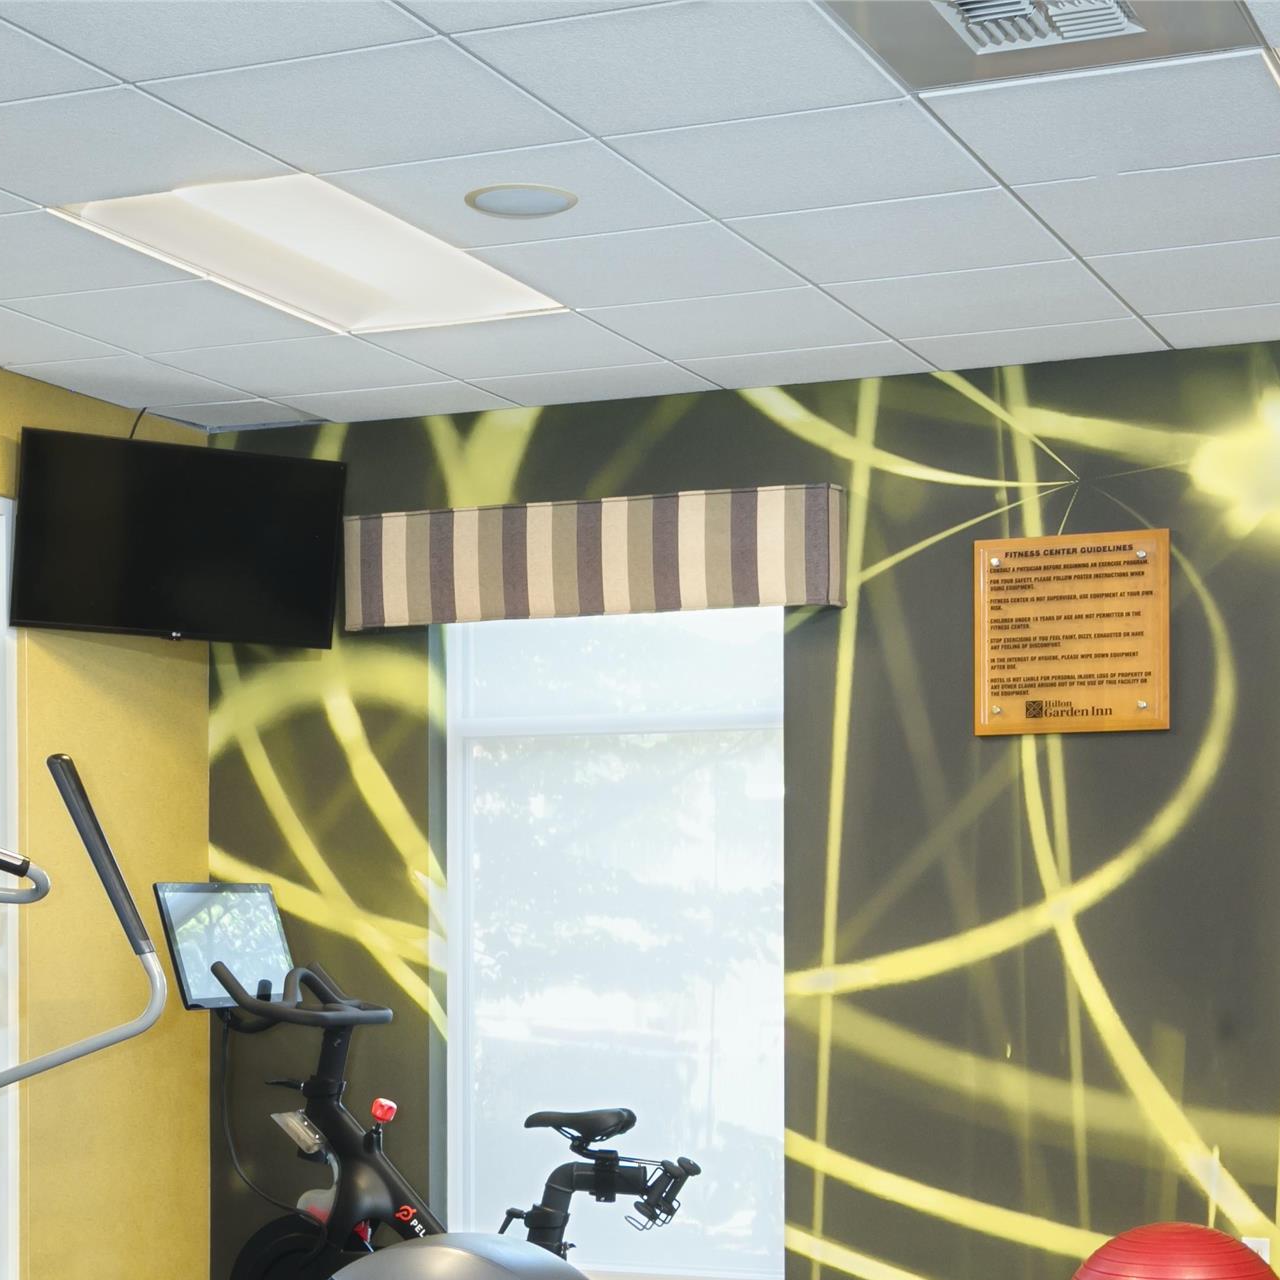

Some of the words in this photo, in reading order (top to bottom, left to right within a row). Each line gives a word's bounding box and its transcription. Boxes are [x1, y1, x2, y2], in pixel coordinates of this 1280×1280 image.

[1005, 550, 1040, 558] FITNESS
[1043, 548, 1077, 556] CENTER
[1080, 544, 1133, 554] GUIDELINES
[1093, 571, 1128, 579] INSTRUCTIONS
[1044, 700, 1072, 708] Hilton
[1044, 707, 1089, 718] Garden
[1092, 706, 1112, 716] Inn
